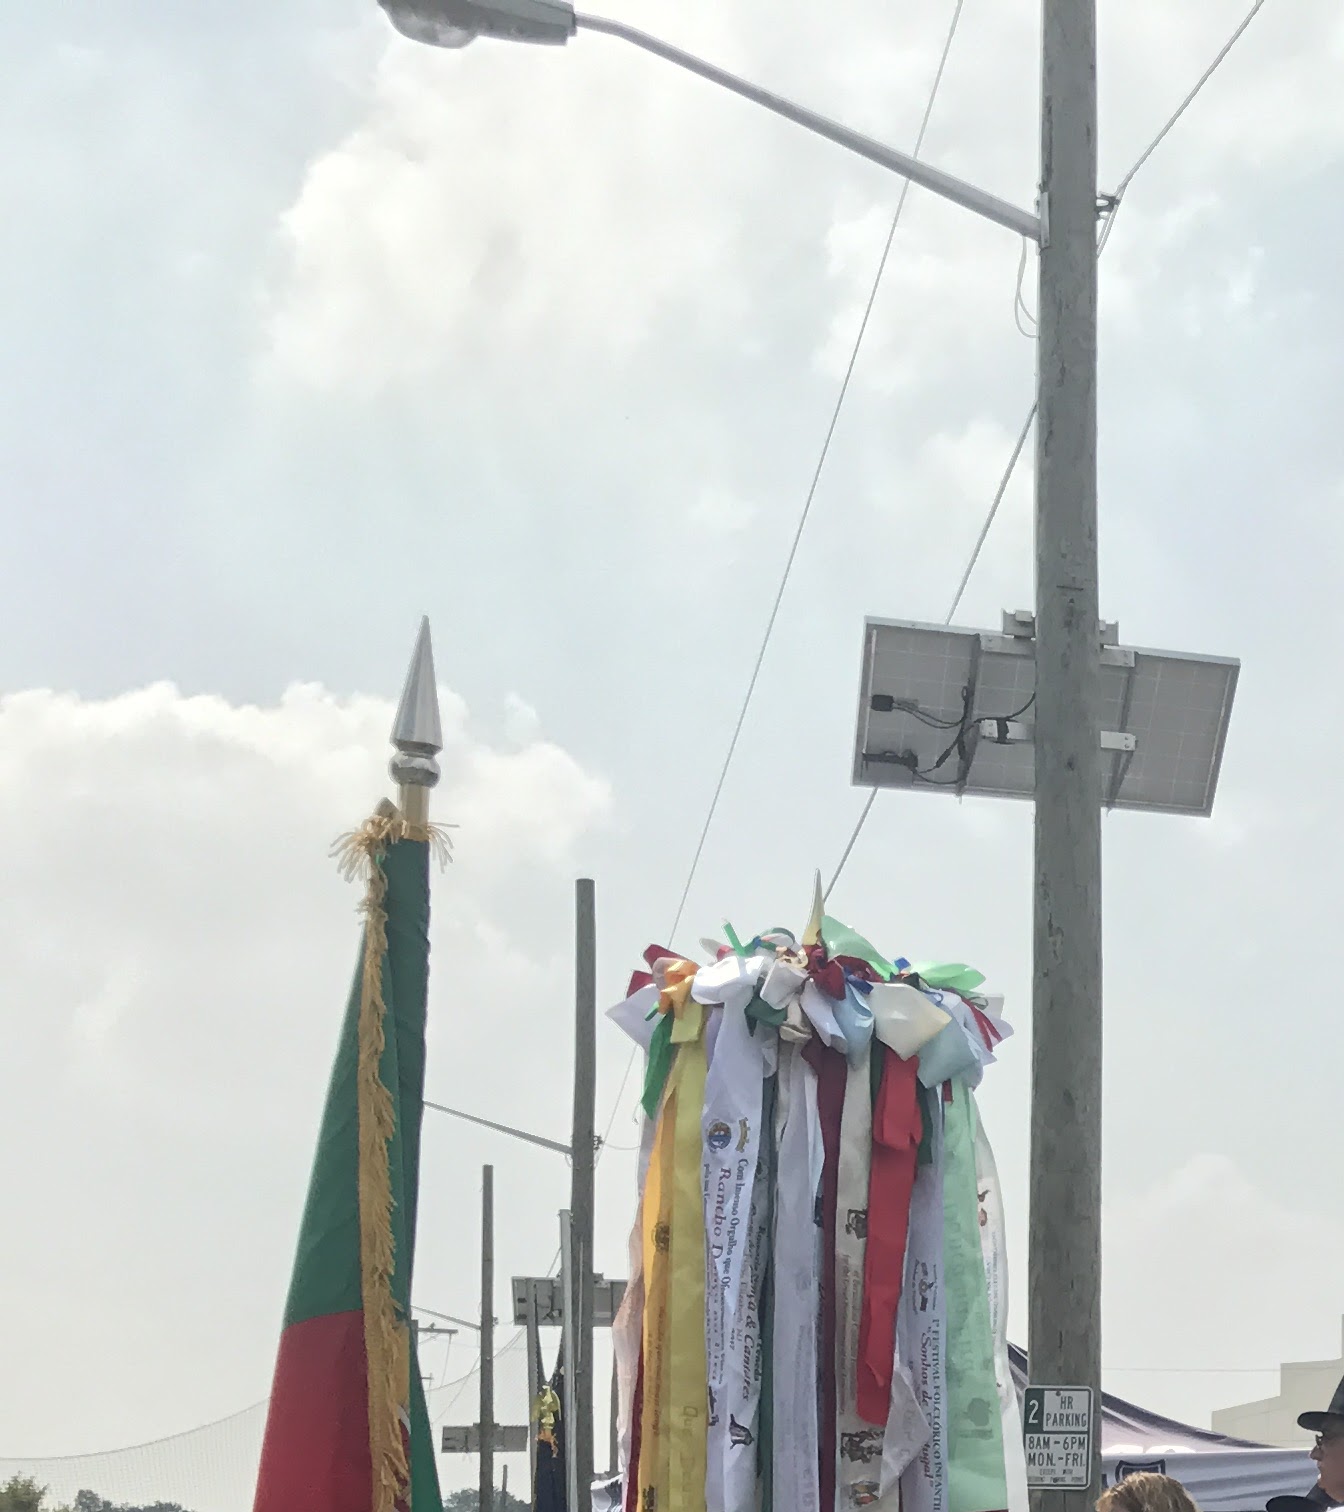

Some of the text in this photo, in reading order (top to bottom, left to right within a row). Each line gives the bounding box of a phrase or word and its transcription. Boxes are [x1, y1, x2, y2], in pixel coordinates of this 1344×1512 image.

[713, 1167, 733, 1238] Rancho
[742, 1333, 756, 1402] Cantares
[931, 1330, 941, 1382] FESTIVAL
[1028, 1399, 1039, 1424] 2
[1045, 1412, 1087, 1428] PARKING
[1059, 1396, 1074, 1410] HR
